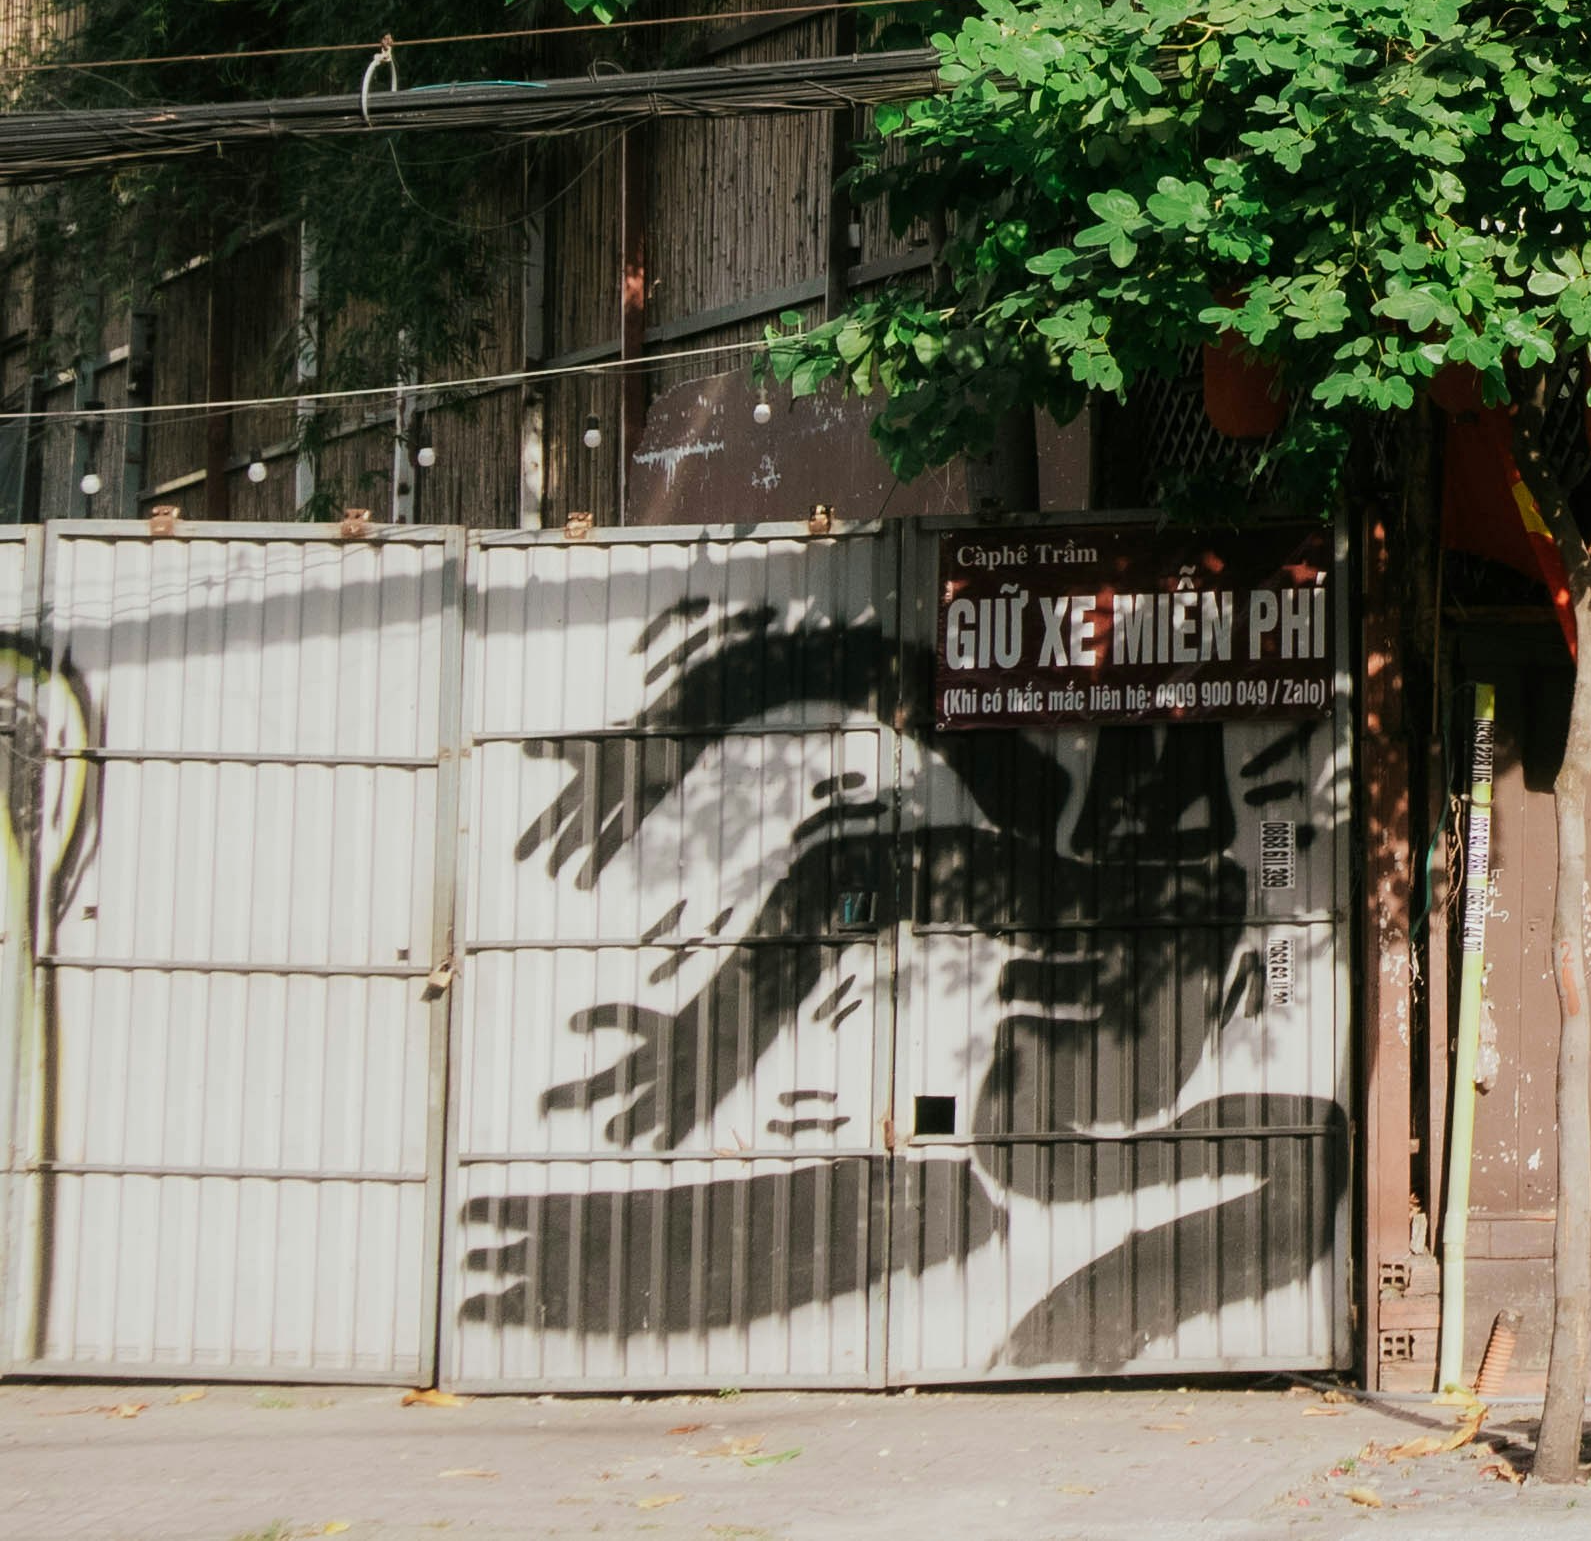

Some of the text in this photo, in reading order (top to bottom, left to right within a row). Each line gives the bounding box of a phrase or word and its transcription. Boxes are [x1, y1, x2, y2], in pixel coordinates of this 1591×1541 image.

[1036, 538, 1099, 565] Trầm
[945, 564, 1329, 670] GIỮ XE MIỄN PHÍ
[981, 687, 1002, 714] có
[1006, 680, 1044, 713] thắc
[1047, 679, 1086, 712] mắc
[1088, 684, 1121, 711] liên
[1154, 682, 1197, 709] 0909
[1200, 681, 1232, 708] 900
[1235, 680, 1268, 707] 049
[1281, 677, 1327, 709] Zalo)
